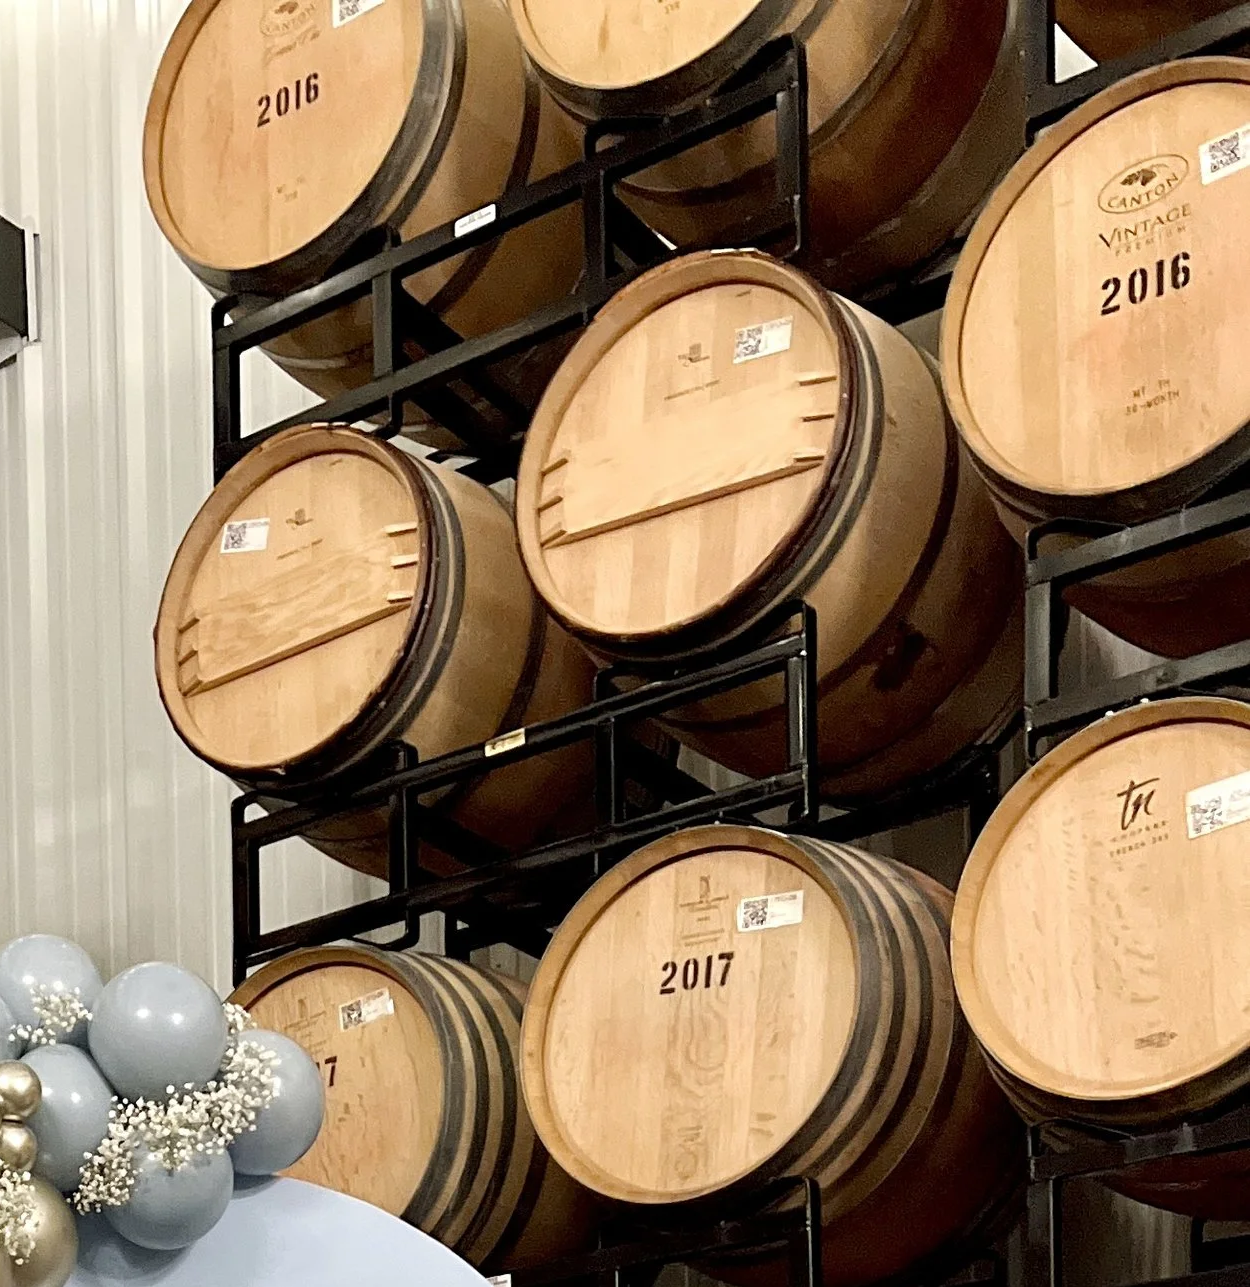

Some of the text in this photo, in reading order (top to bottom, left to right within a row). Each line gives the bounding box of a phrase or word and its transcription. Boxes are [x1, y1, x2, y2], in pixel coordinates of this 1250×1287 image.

[257, 72, 319, 128] 2016
[1107, 172, 1179, 209] CANTON
[1098, 202, 1192, 248] VINTAGE
[1100, 251, 1191, 316] 2016
[659, 951, 735, 995] 2017
